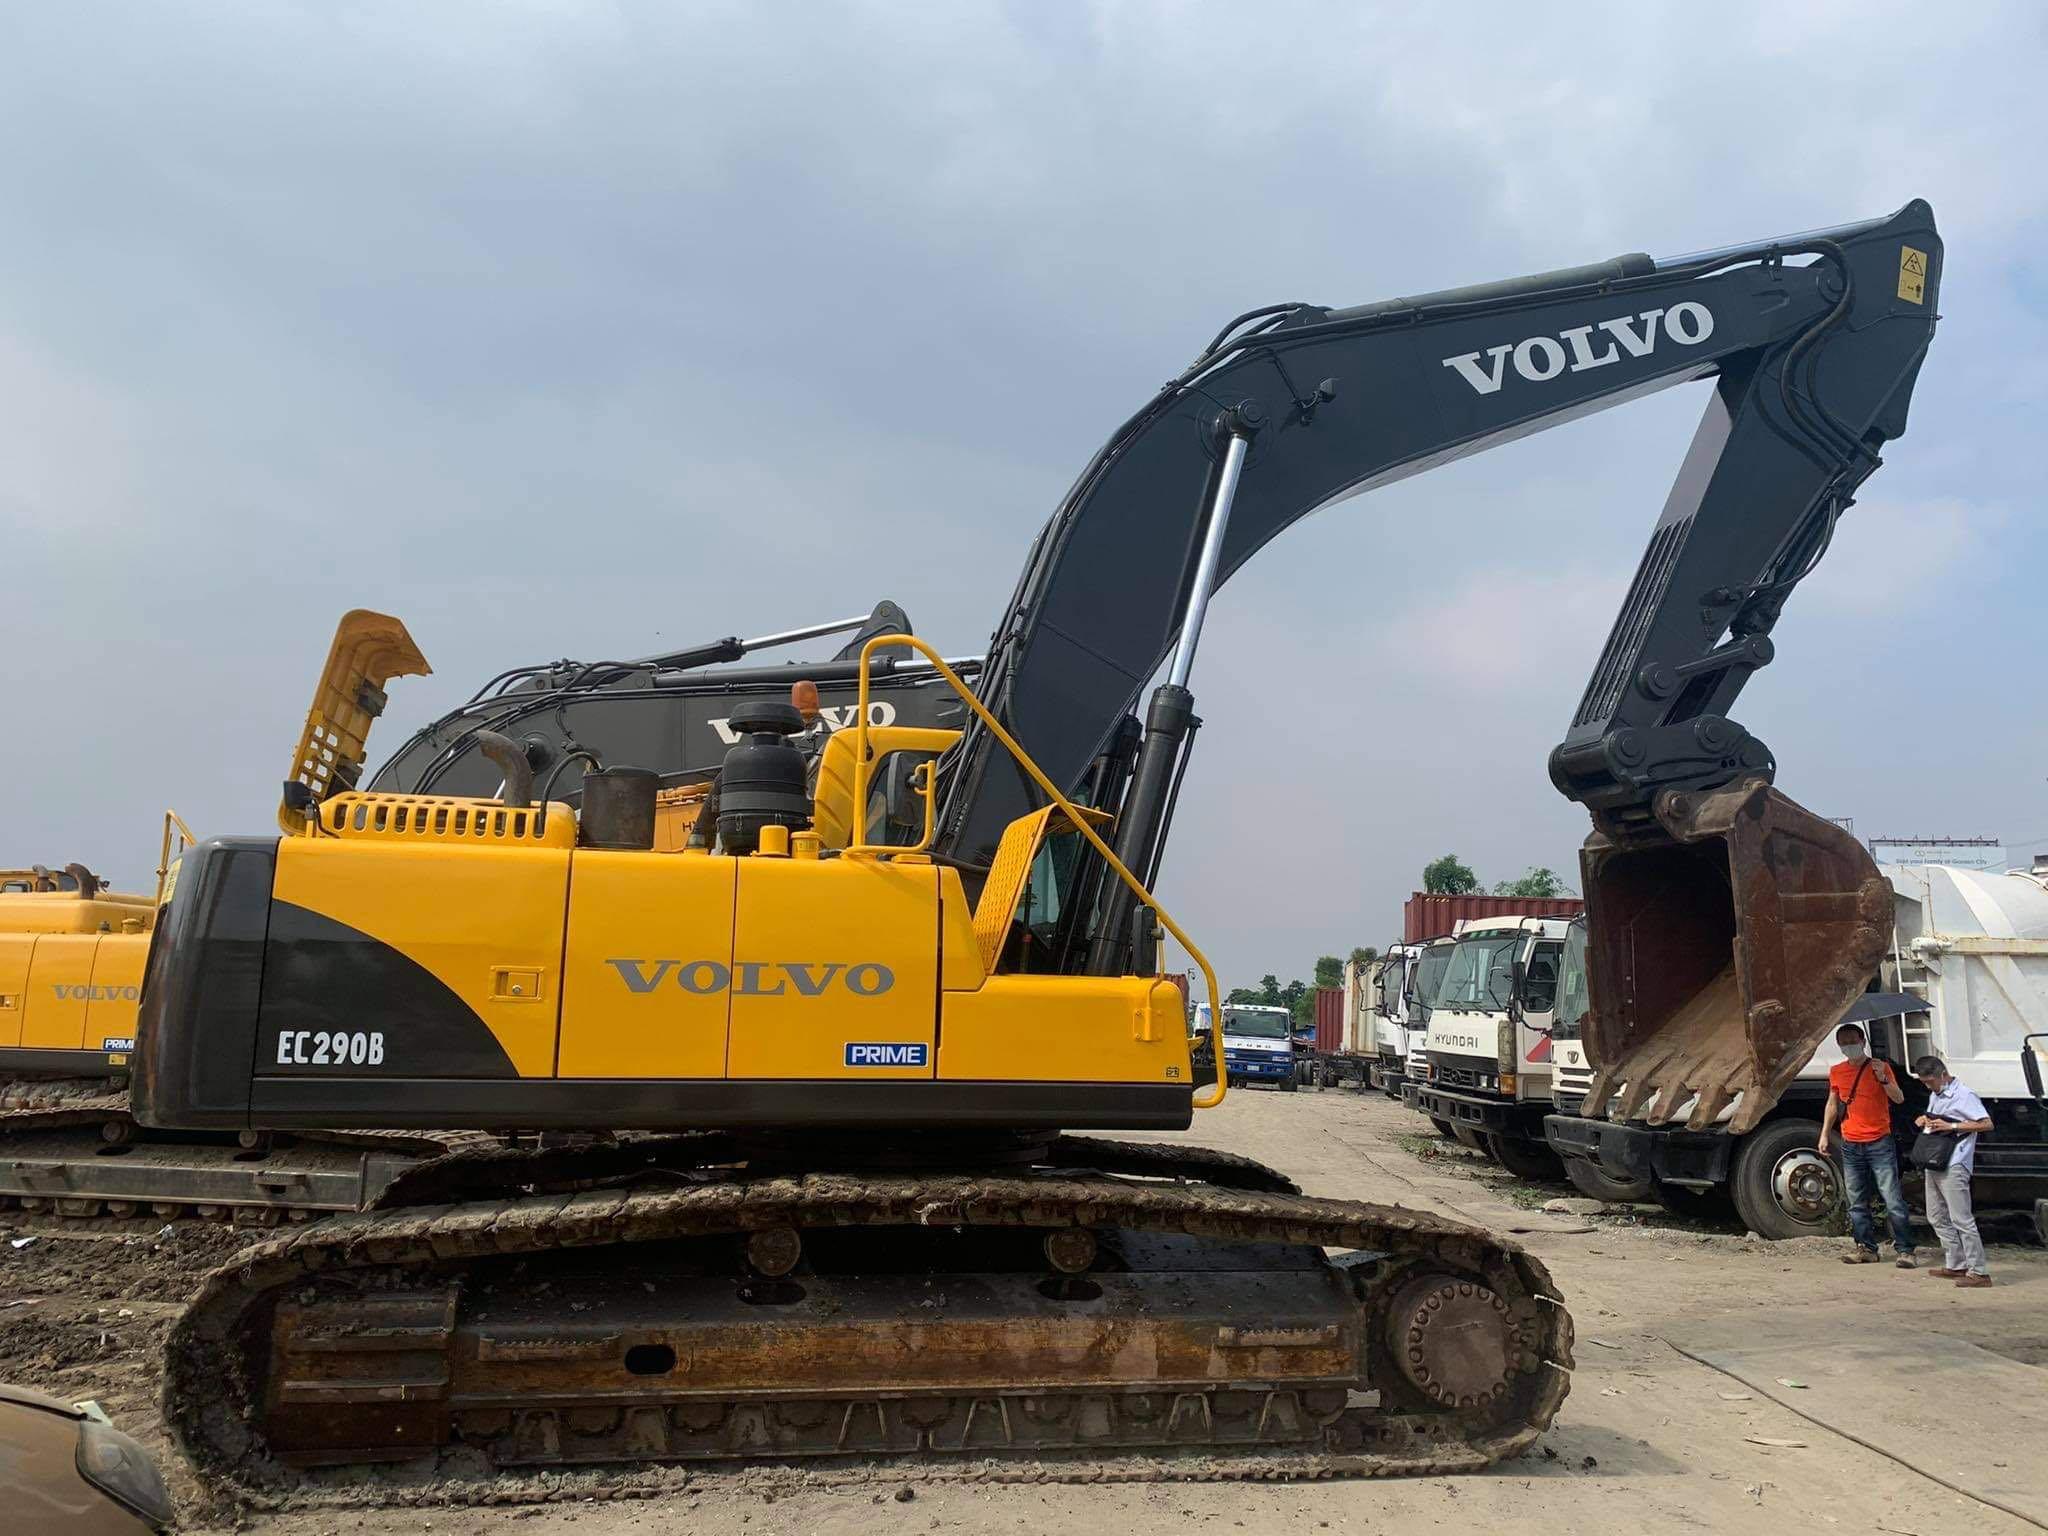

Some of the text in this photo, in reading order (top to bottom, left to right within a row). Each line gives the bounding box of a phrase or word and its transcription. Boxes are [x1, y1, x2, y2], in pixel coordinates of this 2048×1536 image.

[1442, 302, 1714, 395] VOLVO
[707, 702, 896, 744] VVO
[50, 985, 139, 1000] VOLVO
[605, 959, 895, 996] VOLVO
[277, 1030, 384, 1065] EC290B
[851, 1046, 921, 1063] PRIME
[1435, 1034, 1479, 1048] HYUNDAI
